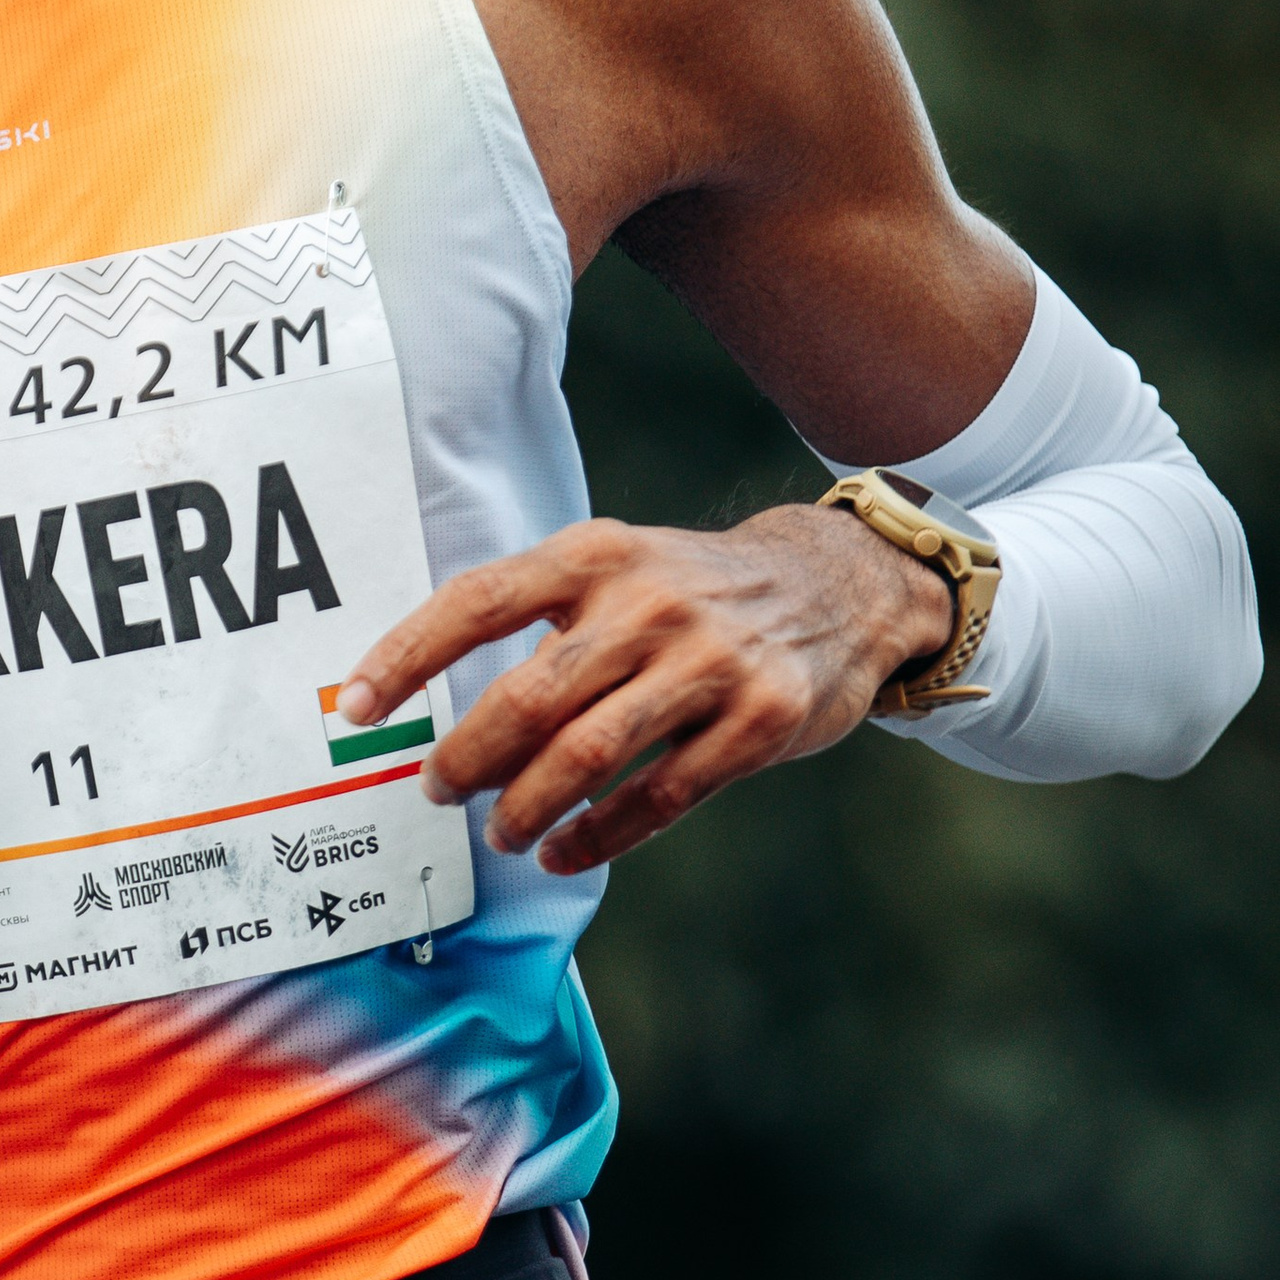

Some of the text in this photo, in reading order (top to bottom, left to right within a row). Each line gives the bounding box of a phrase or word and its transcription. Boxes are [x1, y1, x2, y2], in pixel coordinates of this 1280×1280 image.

[9, 340, 175, 425] 42,2
[31, 744, 99, 807] 11
[309, 824, 336, 837] ЛИГА
[310, 823, 377, 847] МАРАФОНОВ
[114, 841, 228, 887] МОСКОВСКИЙ
[313, 835, 379, 868] BRICS
[118, 880, 170, 909] СПОРТ
[348, 891, 386, 913] сбп
[216, 918, 273, 948] ПСБ
[25, 945, 138, 984] МАГНИТ
